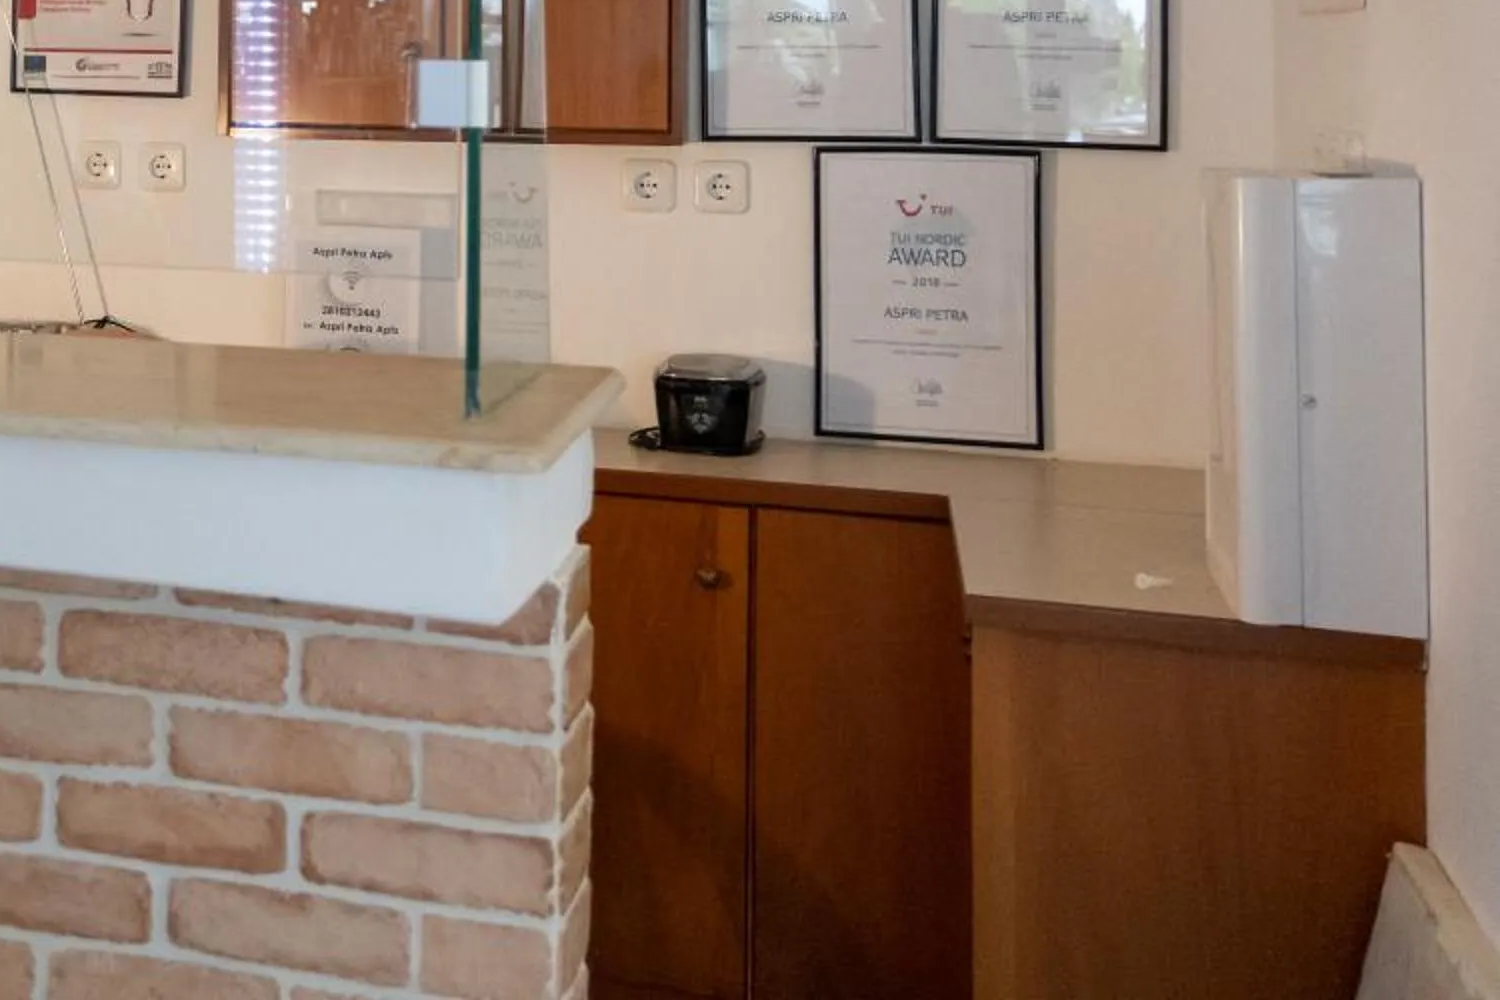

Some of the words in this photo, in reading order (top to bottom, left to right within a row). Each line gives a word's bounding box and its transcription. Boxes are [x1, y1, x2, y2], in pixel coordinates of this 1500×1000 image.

[888, 247, 966, 267] AWARD
[884, 306, 922, 319] ASPRI
[925, 308, 969, 322] PETRA
